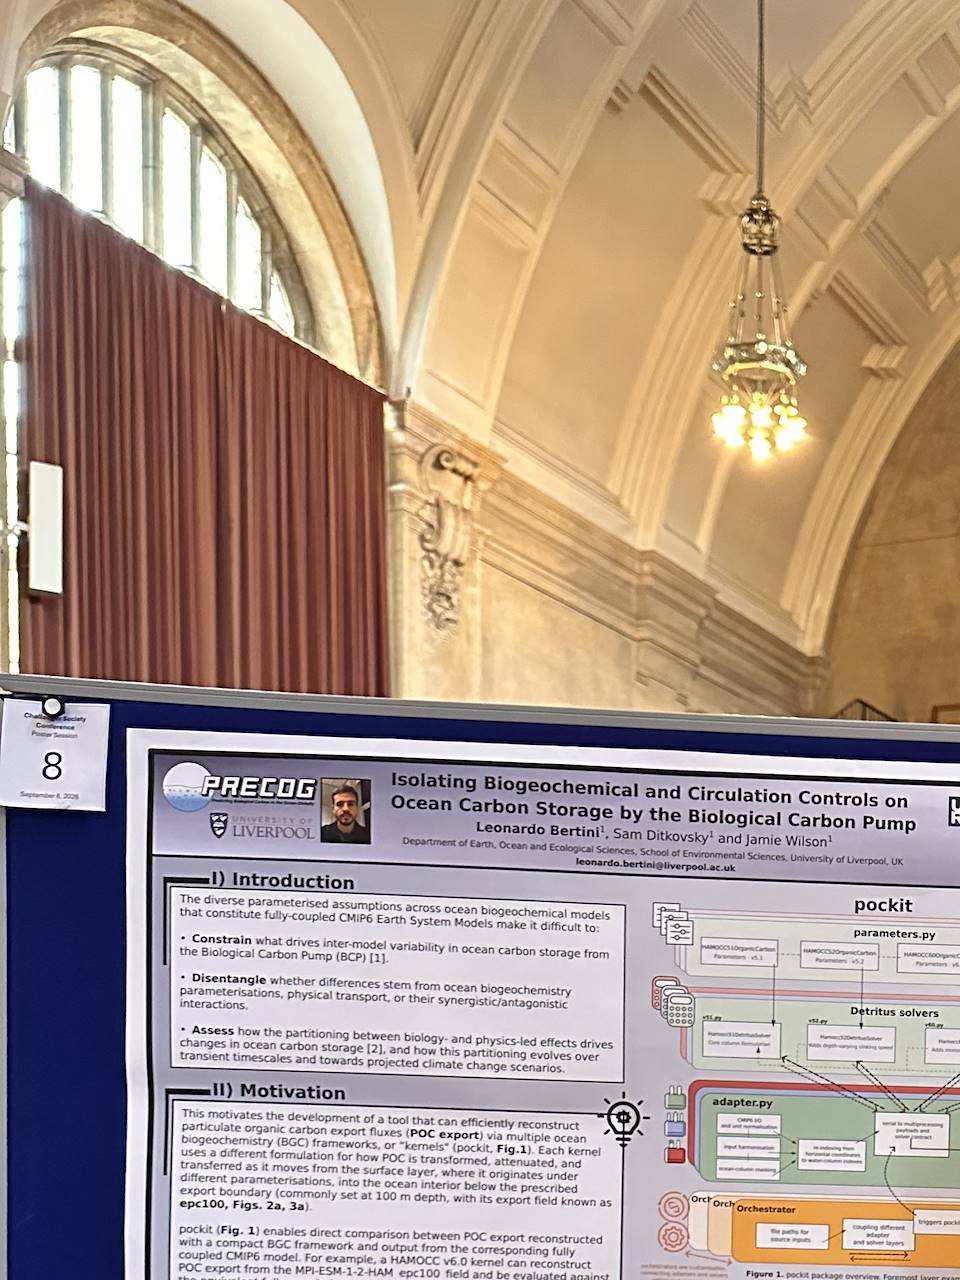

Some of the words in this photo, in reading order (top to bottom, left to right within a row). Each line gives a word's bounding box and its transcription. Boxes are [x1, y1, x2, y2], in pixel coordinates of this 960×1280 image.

[42, 751, 62, 780] 8
[201, 775, 317, 800] PRECOG
[391, 771, 476, 795] Isolating
[485, 775, 638, 800] Biogeochemical
[646, 784, 681, 799] and
[688, 786, 791, 803] Circulation
[799, 790, 878, 806] Controls
[885, 796, 908, 808] on
[232, 815, 294, 824] UNIVERSITY
[391, 794, 452, 810] Ocean
[459, 797, 528, 814] Carbon
[537, 801, 613, 822] Storage
[621, 804, 643, 823] by
[649, 806, 681, 822] the
[689, 809, 780, 830] Biological
[788, 812, 855, 829] Carbon
[863, 815, 916, 835] Pump
[232, 825, 315, 840] LIVERPOOL
[476, 821, 545, 835] Leonardo
[614, 828, 642, 840] Sam
[719, 833, 741, 844] and
[745, 834, 781, 846] Jamie
[402, 836, 456, 848] Department
[458, 838, 468, 847] of
[470, 840, 496, 849] Earth,
[499, 841, 528, 850] Ocean
[530, 842, 547, 851] and
[550, 843, 594, 854] Ecological
[596, 845, 637, 856] Sciences,
[640, 847, 669, 857] School
[672, 848, 681, 857] of
[683, 849, 745, 860] Environmental
[748, 851, 787, 862] Sciences,
[790, 853, 833, 865] University
[836, 855, 846, 864] of
[847, 856, 889, 867] Liverpool,
[891, 857, 903, 866] UK
[575, 857, 736, 873] leonardo.bertini@liverpool.ac.uk
[211, 871, 225, 888] I)
[232, 872, 355, 890] Introduction
[180, 894, 201, 905] The
[204, 895, 245, 906] diverse
[248, 897, 329, 911] parameterised
[332, 900, 402, 914] assumptions
[406, 904, 441, 914] across
[444, 906, 477, 915] ocean
[481, 905, 567, 920] biogeochemical
[571, 909, 610, 920] models
[854, 898, 913, 914] pockit
[854, 928, 936, 941] parameters.py
[851, 1006, 896, 1017] Detritus
[899, 1008, 939, 1018] solvers
[213, 1082, 234, 1100] II)
[240, 1083, 346, 1101] Motivation
[712, 1096, 773, 1110] adapter.py
[182, 1108, 204, 1118] This
[207, 1110, 263, 1120] motivates
[266, 1112, 284, 1121] the
[288, 1111, 360, 1125] development
[364, 1113, 376, 1123] of
[388, 1115, 410, 1124] tool
[412, 1116, 435, 1125] that
[438, 1118, 457, 1127] can
[461, 1117, 515, 1131] efficiently
[518, 1120, 579, 1131] reconstruct
[737, 1204, 796, 1214] Orchestrator
